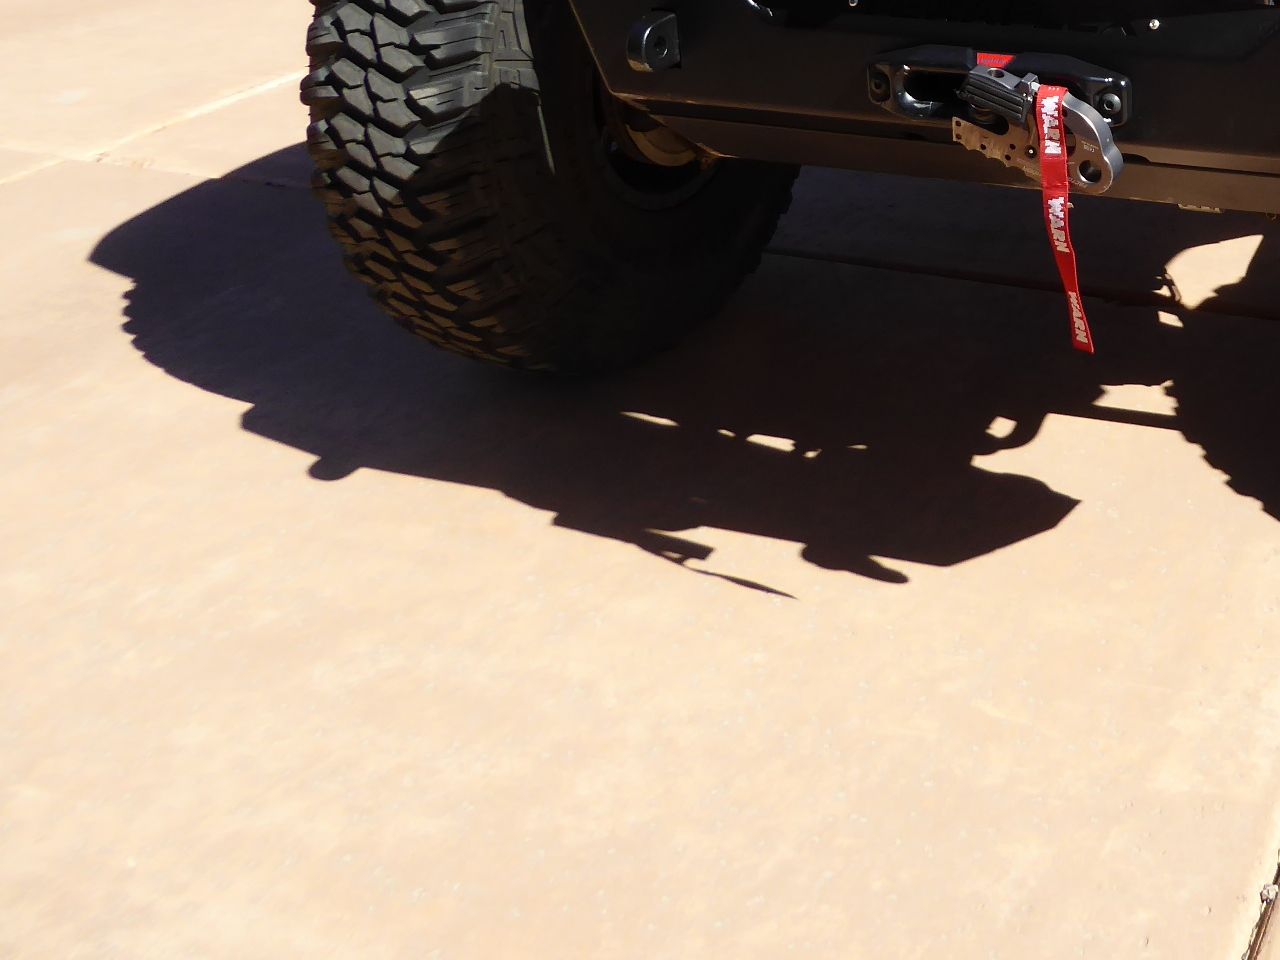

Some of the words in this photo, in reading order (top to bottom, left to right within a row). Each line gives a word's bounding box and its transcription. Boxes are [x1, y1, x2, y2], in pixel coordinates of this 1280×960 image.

[1041, 96, 1062, 154] WARN
[1048, 196, 1070, 253] WARN
[1068, 291, 1088, 344] WARN
